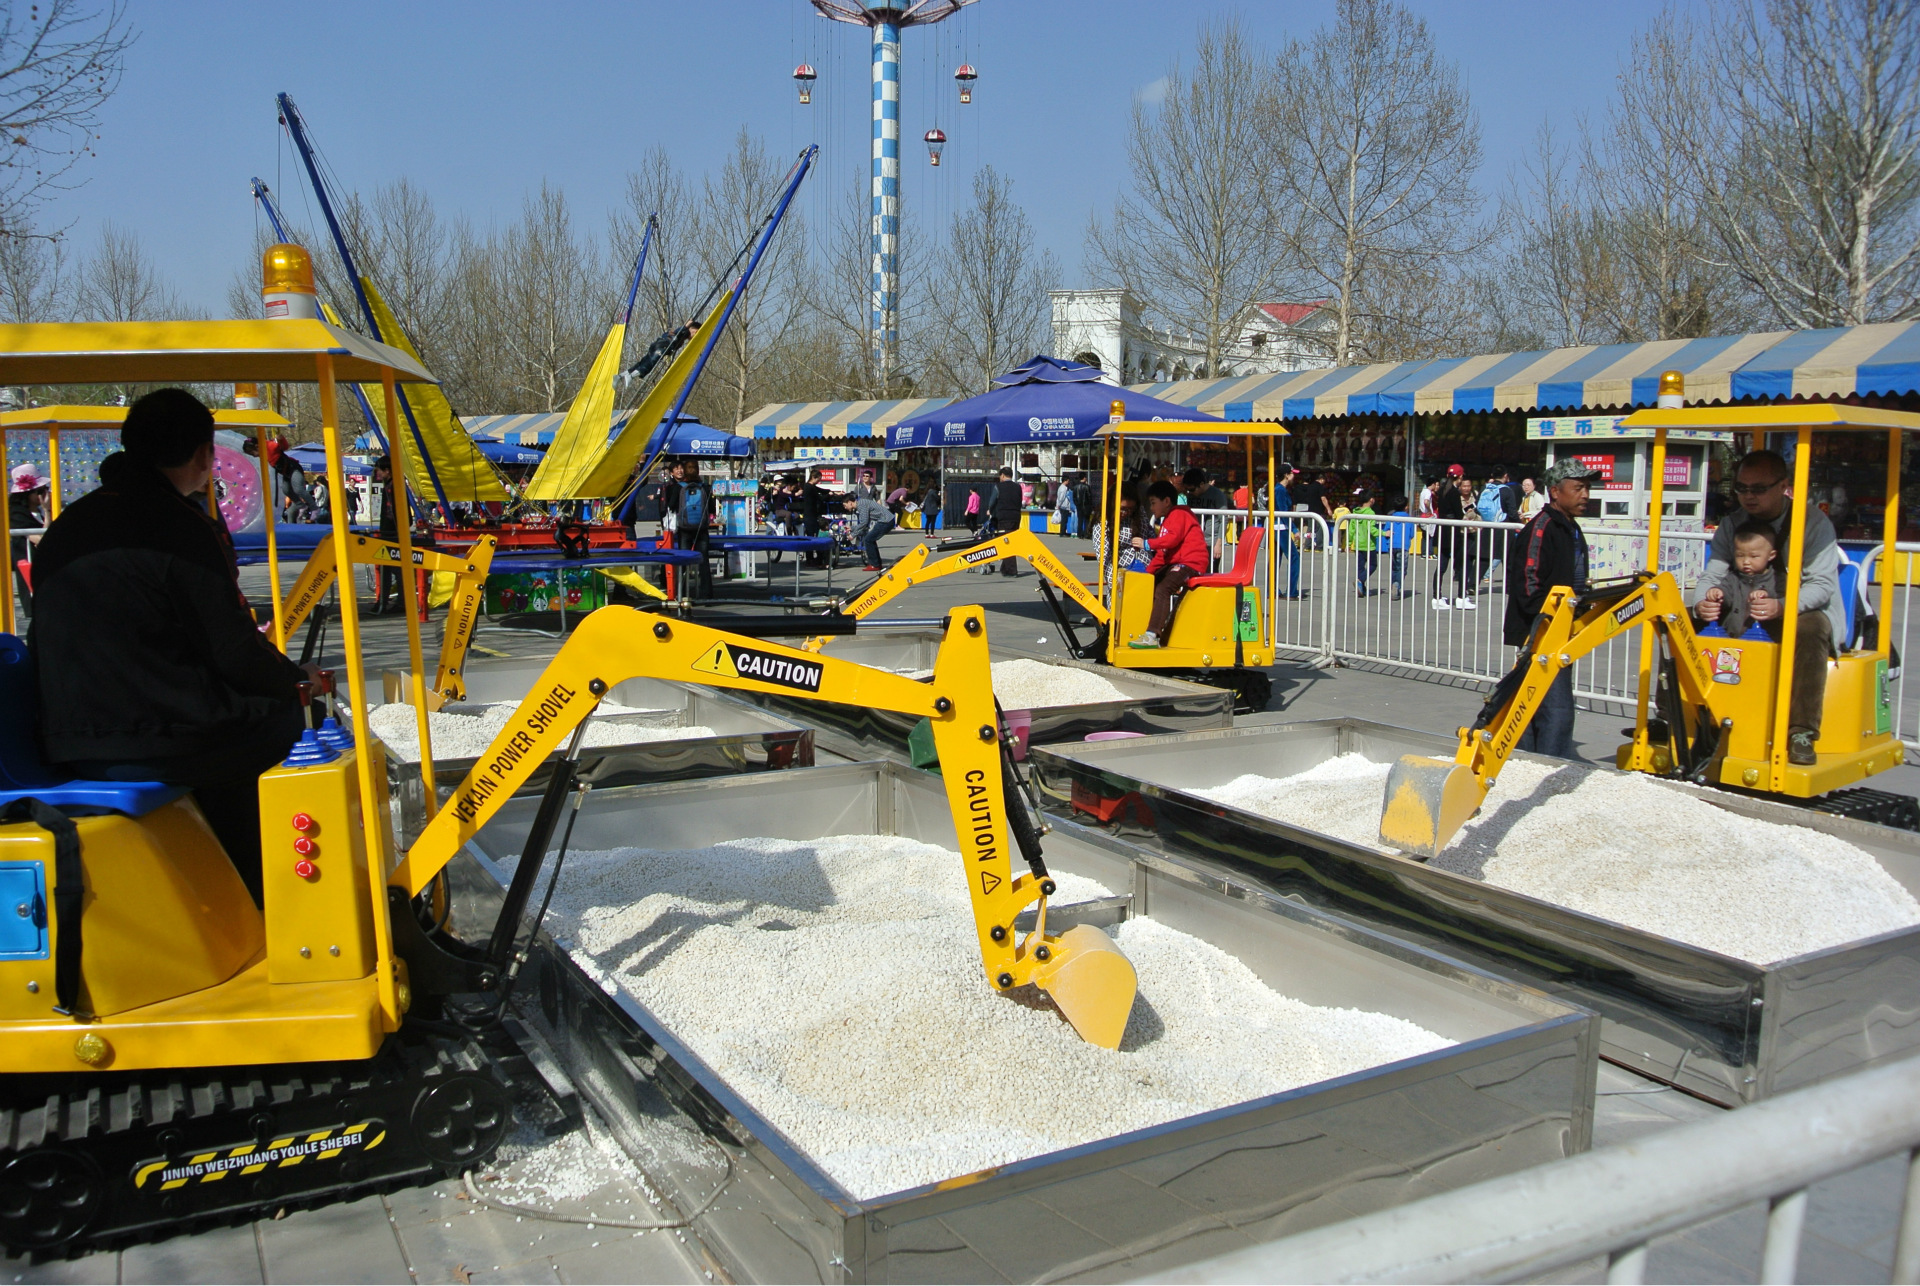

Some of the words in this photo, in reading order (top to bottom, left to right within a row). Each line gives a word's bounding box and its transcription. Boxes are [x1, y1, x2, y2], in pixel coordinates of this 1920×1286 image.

[390, 549, 423, 563] CAON
[966, 547, 997, 563] CAUTION
[292, 592, 312, 616] POWER
[309, 569, 328, 595] SHOVEL
[1037, 554, 1055, 572] VEKAIN
[1052, 568, 1070, 586] POWER
[1067, 582, 1086, 601] SHOVEL
[458, 594, 474, 636] CAUTION
[851, 594, 878, 617] AUTION
[1616, 597, 1644, 624] CAUTION
[737, 653, 820, 687] CAUTION
[1495, 702, 1528, 760] CAUTION
[451, 774, 499, 824] VEKAIN
[489, 730, 536, 780] POWER
[527, 683, 577, 734] SHOVEL
[964, 769, 998, 862] CAUTION
[161, 1164, 203, 1182] JINING
[205, 1149, 278, 1173] WEIZHUANG
[280, 1144, 318, 1159] YOULE
[320, 1133, 362, 1151] SHEBEI
